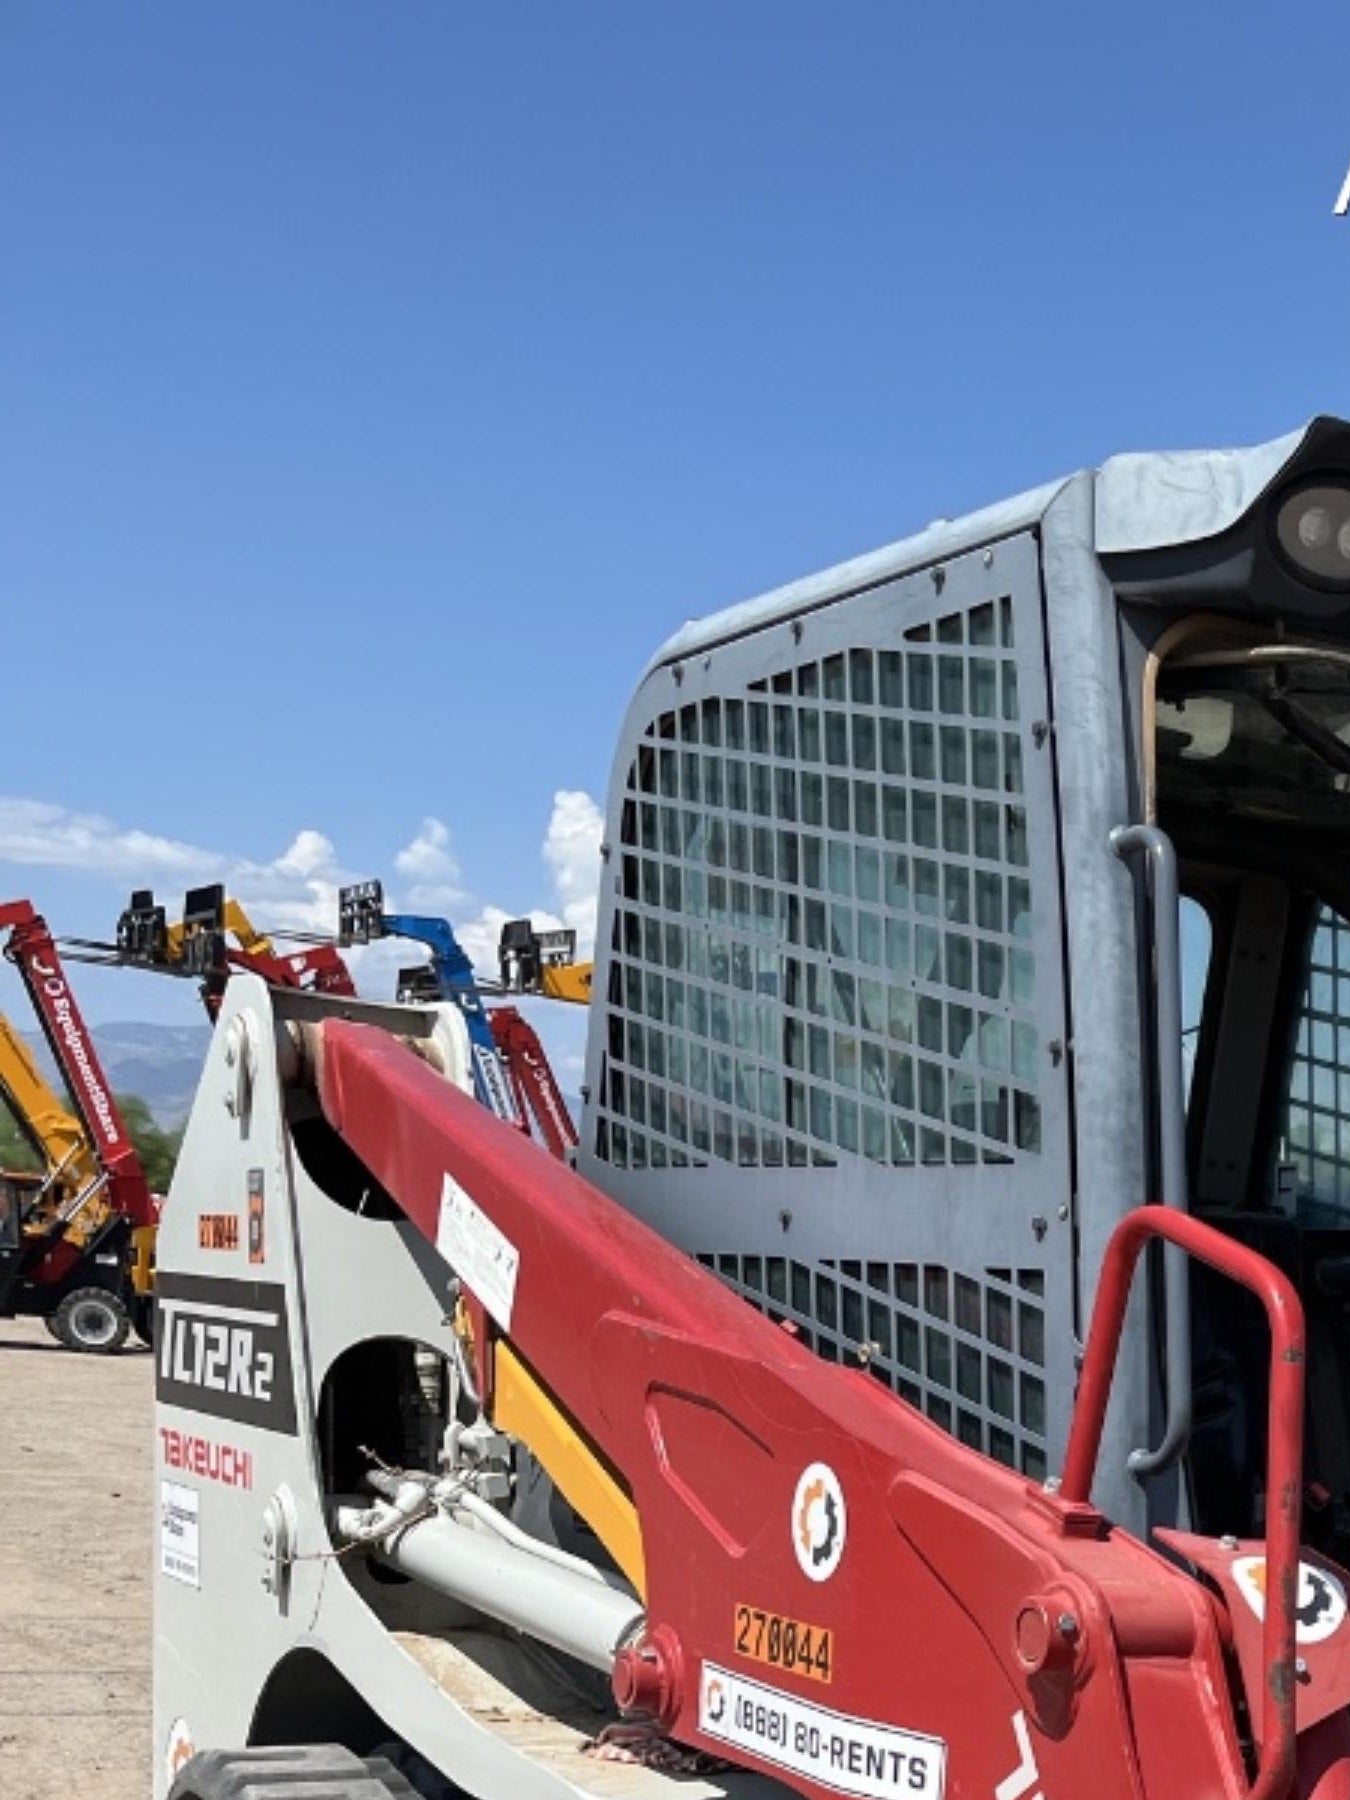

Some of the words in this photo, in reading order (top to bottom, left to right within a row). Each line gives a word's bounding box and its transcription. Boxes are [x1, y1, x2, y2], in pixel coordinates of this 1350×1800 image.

[158, 1298, 279, 1402] TL12R2
[736, 1606, 830, 1679] 270044
[794, 1720, 929, 1791] 80-RENTS
